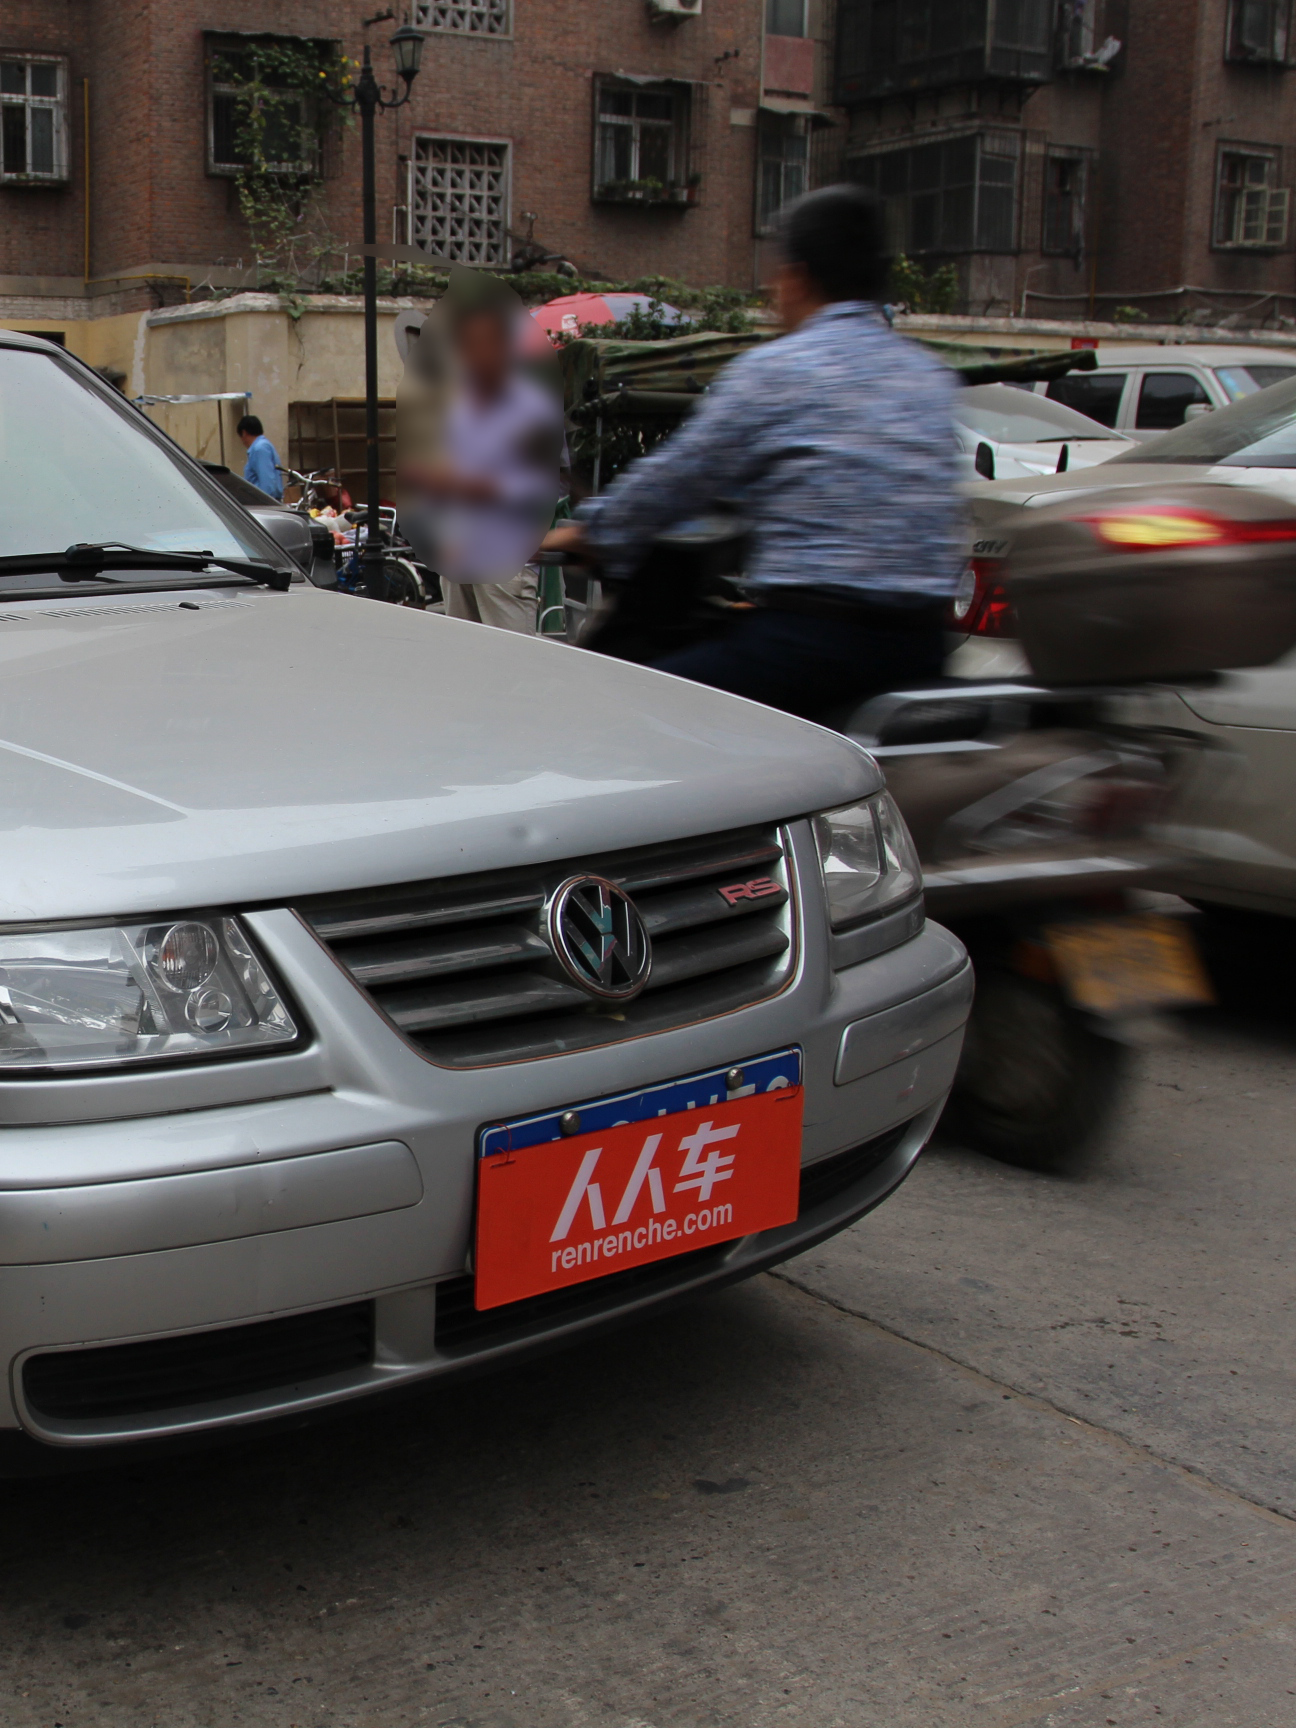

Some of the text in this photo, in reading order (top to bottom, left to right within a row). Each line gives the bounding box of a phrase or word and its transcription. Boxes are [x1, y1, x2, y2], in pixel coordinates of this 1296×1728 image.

[718, 877, 781, 907] RS
[549, 1120, 741, 1243] 人人车
[551, 1203, 733, 1272] renrenche.com
